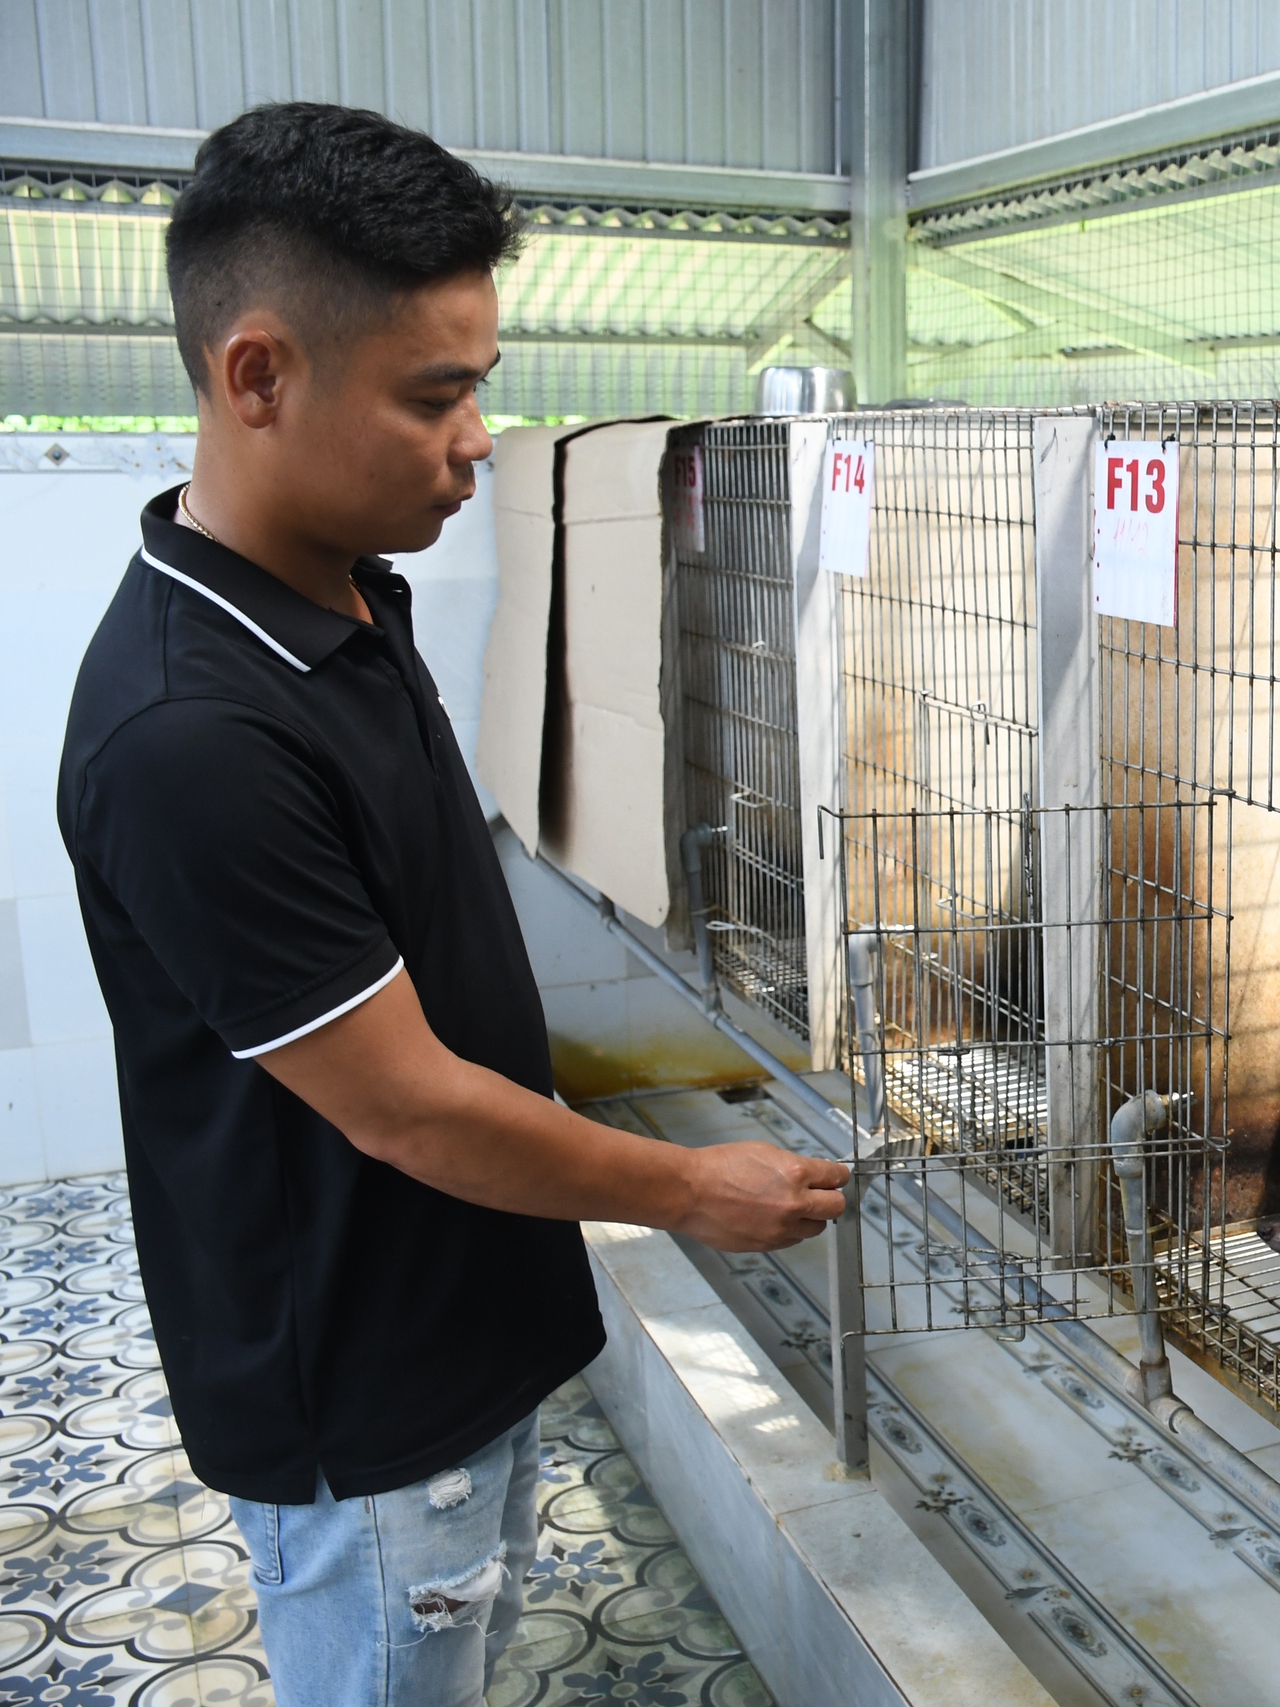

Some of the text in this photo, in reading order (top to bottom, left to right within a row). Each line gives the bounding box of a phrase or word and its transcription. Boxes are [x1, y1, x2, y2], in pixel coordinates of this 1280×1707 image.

[674, 454, 697, 488] F15
[832, 453, 865, 494] F14
[1107, 457, 1166, 514] F13
